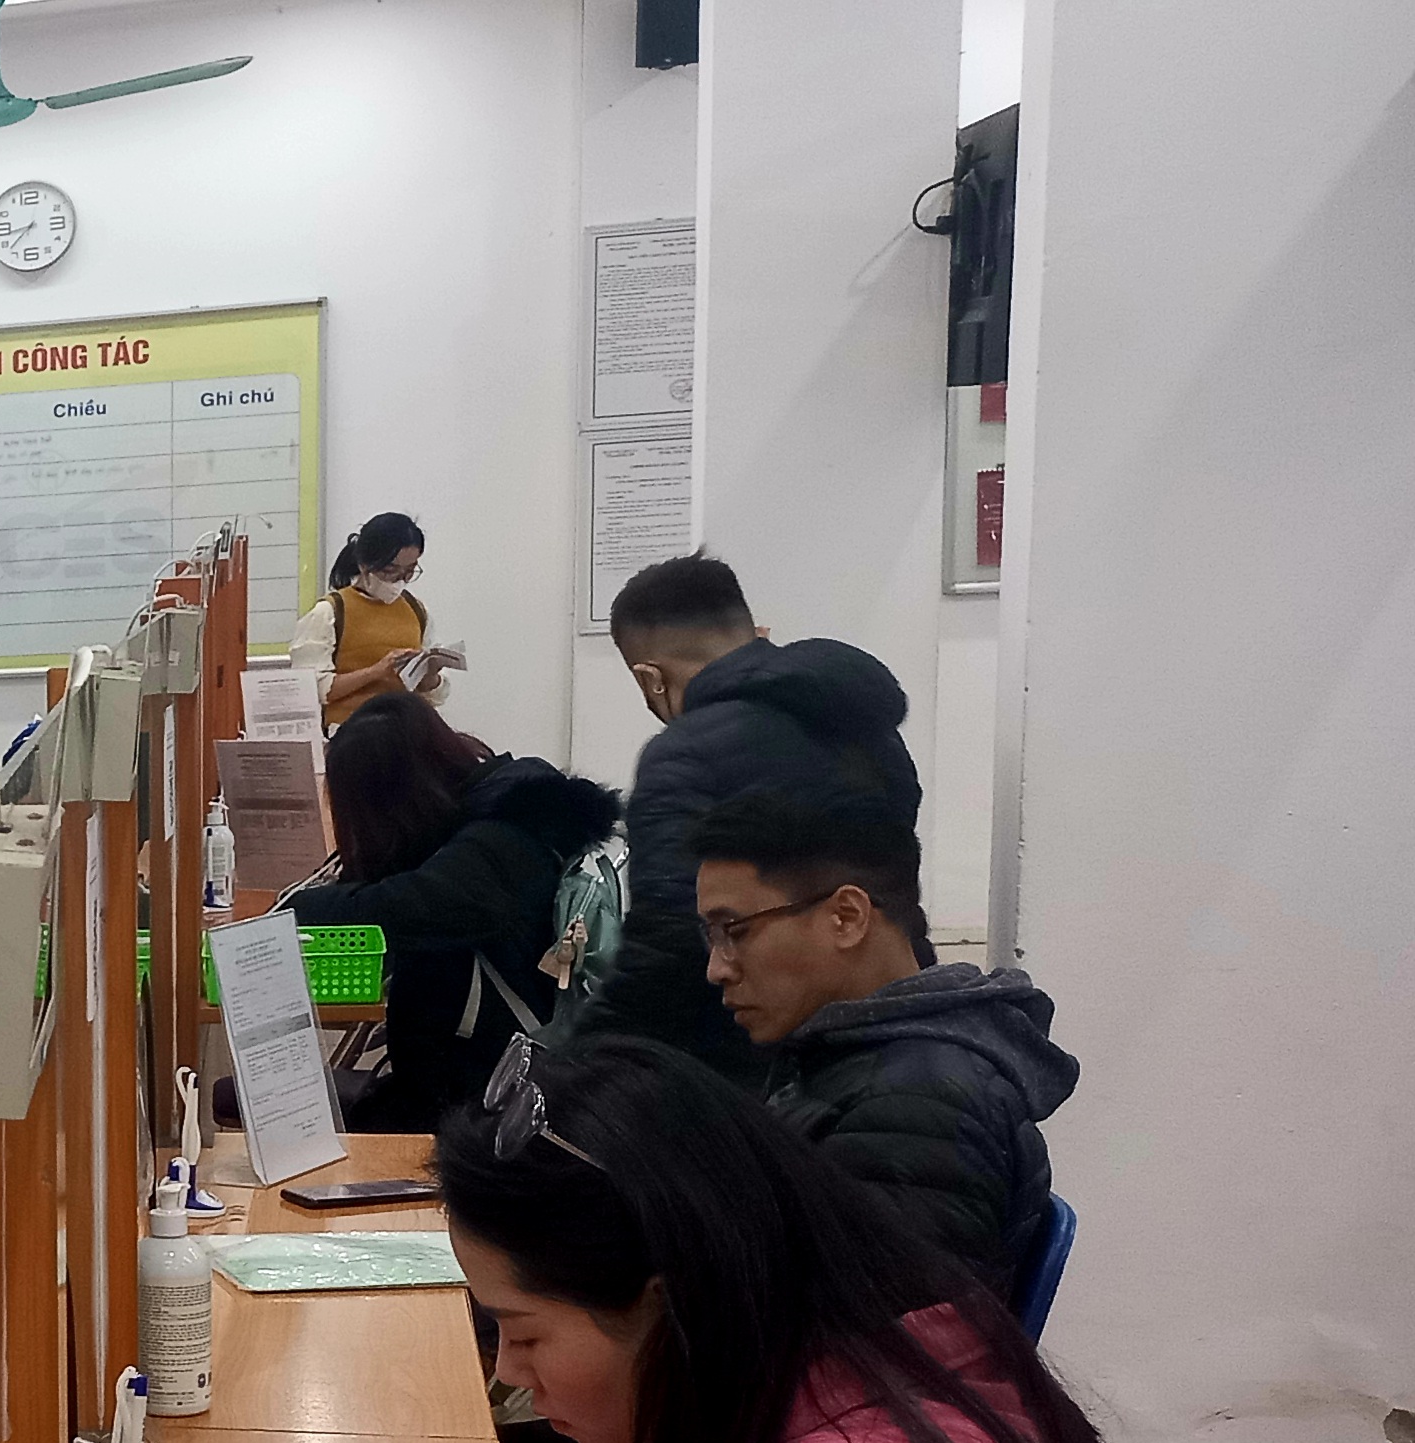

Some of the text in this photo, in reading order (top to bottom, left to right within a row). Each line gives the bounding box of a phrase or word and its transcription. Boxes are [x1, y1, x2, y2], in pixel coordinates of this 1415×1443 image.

[20, 191, 39, 205] 12
[50, 216, 65, 231] 3
[24, 247, 39, 261] 6
[13, 342, 88, 374] CÔNG
[96, 336, 151, 366] TÁC
[200, 387, 275, 408] Ghi chú
[53, 398, 108, 418] Chiều
